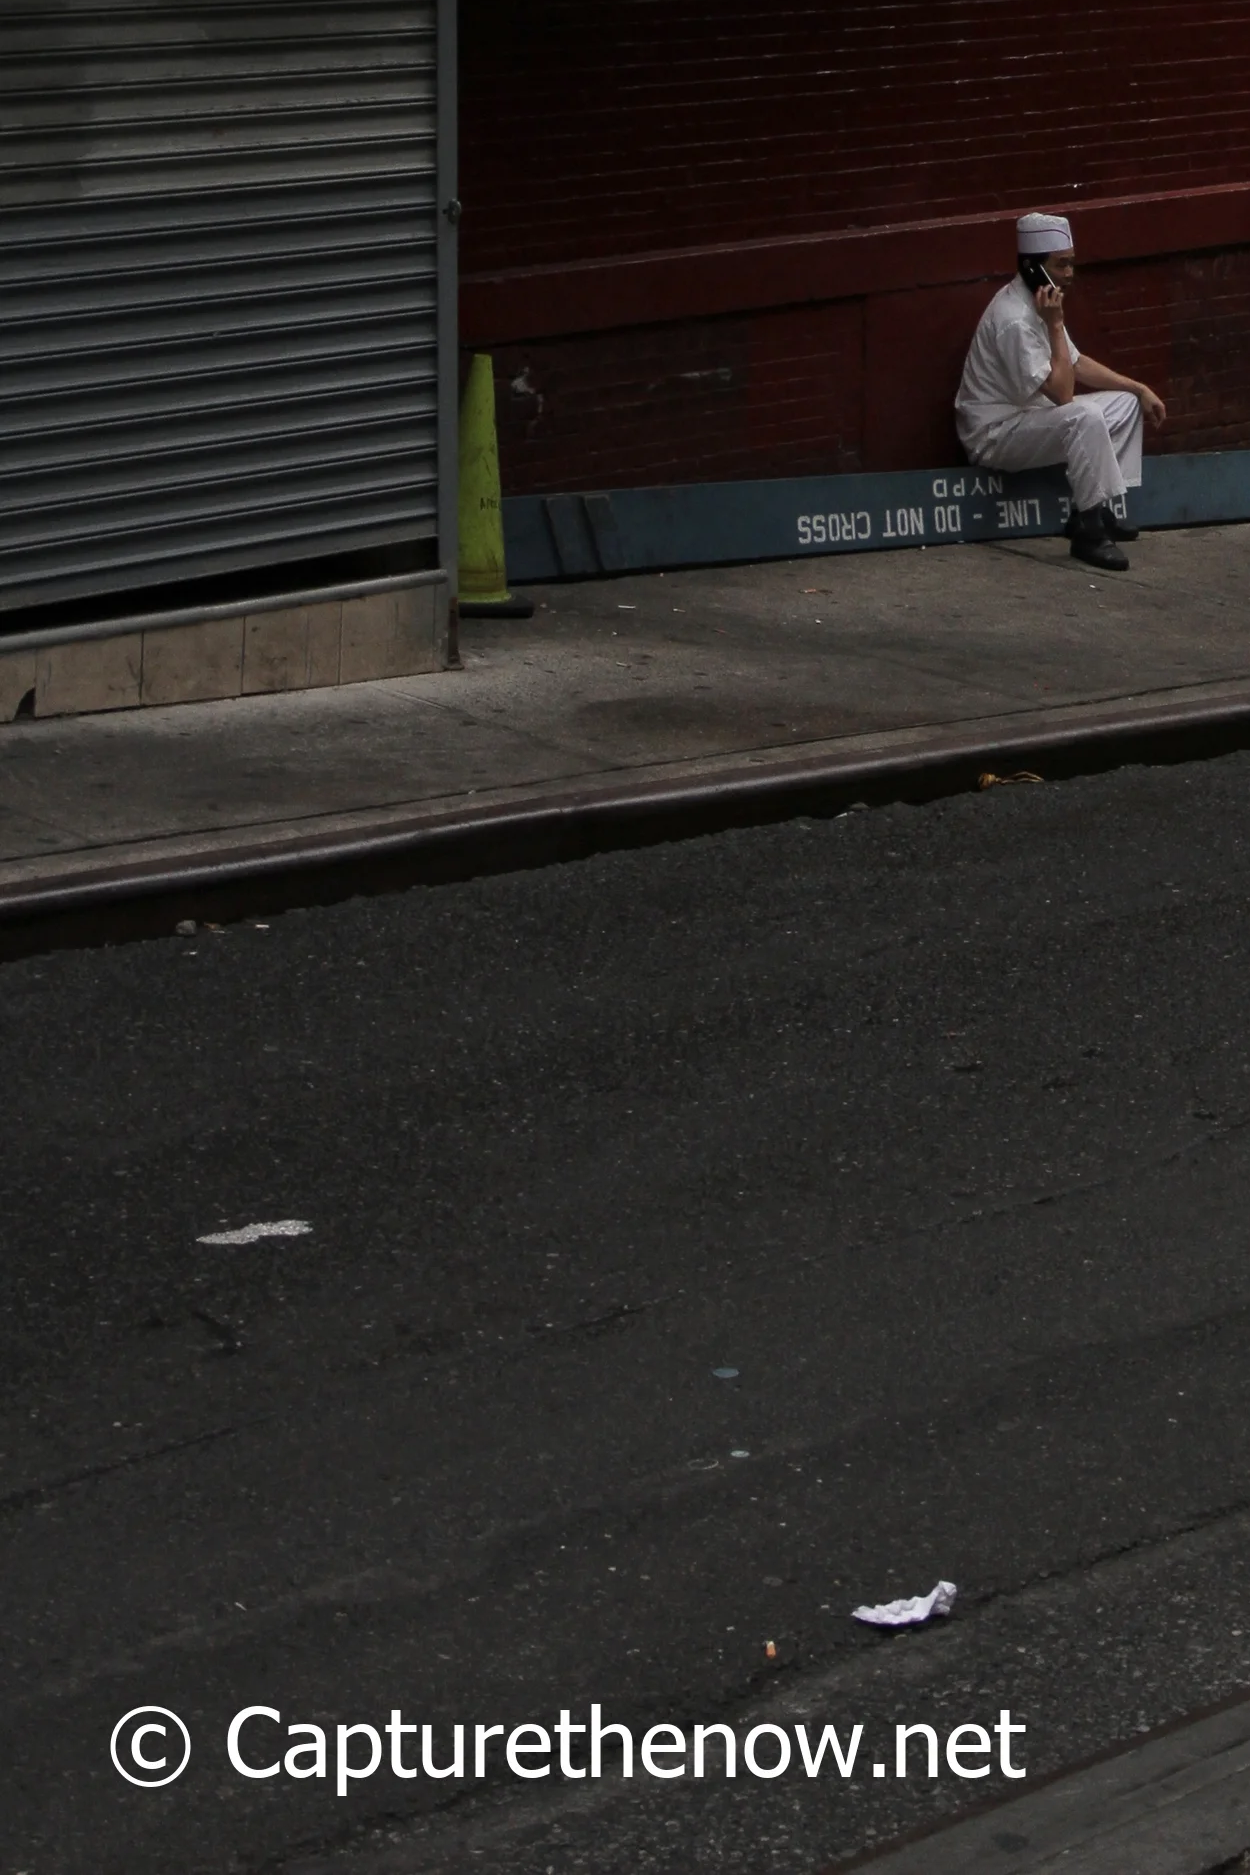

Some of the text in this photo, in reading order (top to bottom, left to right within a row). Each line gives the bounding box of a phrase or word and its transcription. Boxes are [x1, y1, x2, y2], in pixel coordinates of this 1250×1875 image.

[932, 475, 1004, 498] NYPD
[797, 511, 872, 545] CROSS
[882, 506, 925, 538] NOT
[934, 505, 962, 534] DO
[996, 498, 1041, 529] LINE
